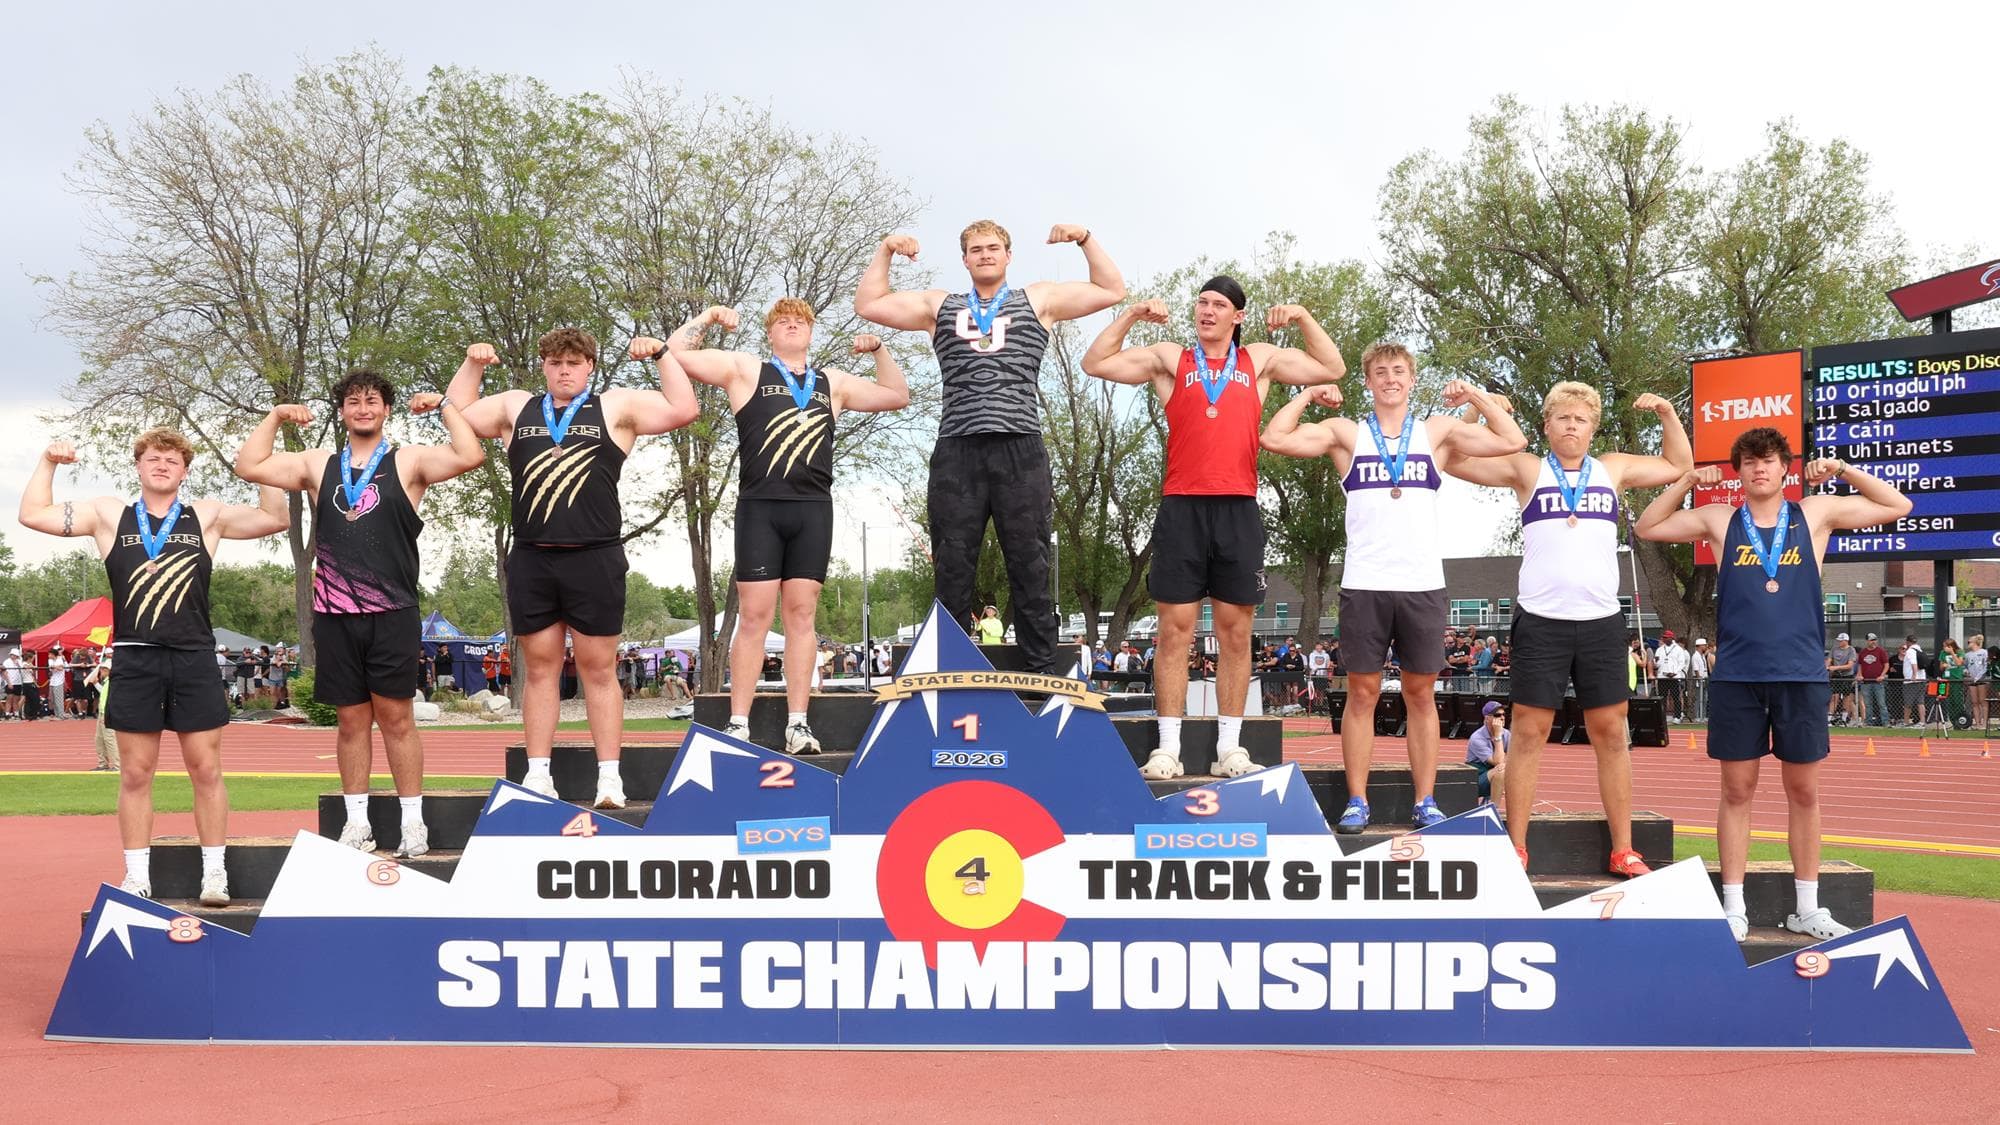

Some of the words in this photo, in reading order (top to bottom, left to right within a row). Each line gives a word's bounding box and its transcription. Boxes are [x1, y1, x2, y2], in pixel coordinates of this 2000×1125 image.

[1819, 360, 1914, 382] RESULTS:
[1918, 359, 1961, 375] Boys
[1816, 385, 1837, 401] 10
[1847, 374, 1966, 399] Oringdulph
[1816, 405, 1838, 420] 11
[1848, 397, 1930, 418] Salgado
[518, 425, 601, 440] BERS
[1816, 425, 1837, 441] 12
[1849, 420, 1895, 438] Cain
[1816, 444, 1837, 460] 13
[1849, 440, 1954, 459] Uhlianets
[1356, 461, 1428, 483] TIGRS
[1817, 479, 1837, 494] 15
[1896, 517, 1954, 532] Essen
[1838, 533, 1907, 552] Harris
[901, 673, 965, 689] STATE
[970, 673, 1080, 693] CHAMPION
[952, 713, 980, 742] 1
[934, 751, 1006, 767] 2026
[759, 761, 796, 789] 2
[1184, 788, 1222, 817] 3
[561, 812, 599, 839] 4
[744, 826, 826, 846] BOYS
[1146, 833, 1259, 850] DISCUS
[1390, 834, 1425, 862] 5
[366, 859, 401, 886] 6
[537, 860, 831, 899] COLORADO
[955, 857, 990, 882] 4
[1079, 860, 1271, 900] TRACK
[1282, 860, 1322, 900] &
[1331, 860, 1478, 900] FIELD
[1590, 891, 1625, 920] 7
[167, 915, 204, 944] 8
[438, 940, 723, 1008] STATE
[740, 940, 1557, 1011] CHAMPIONSHIPS
[1794, 951, 1831, 978] 9
